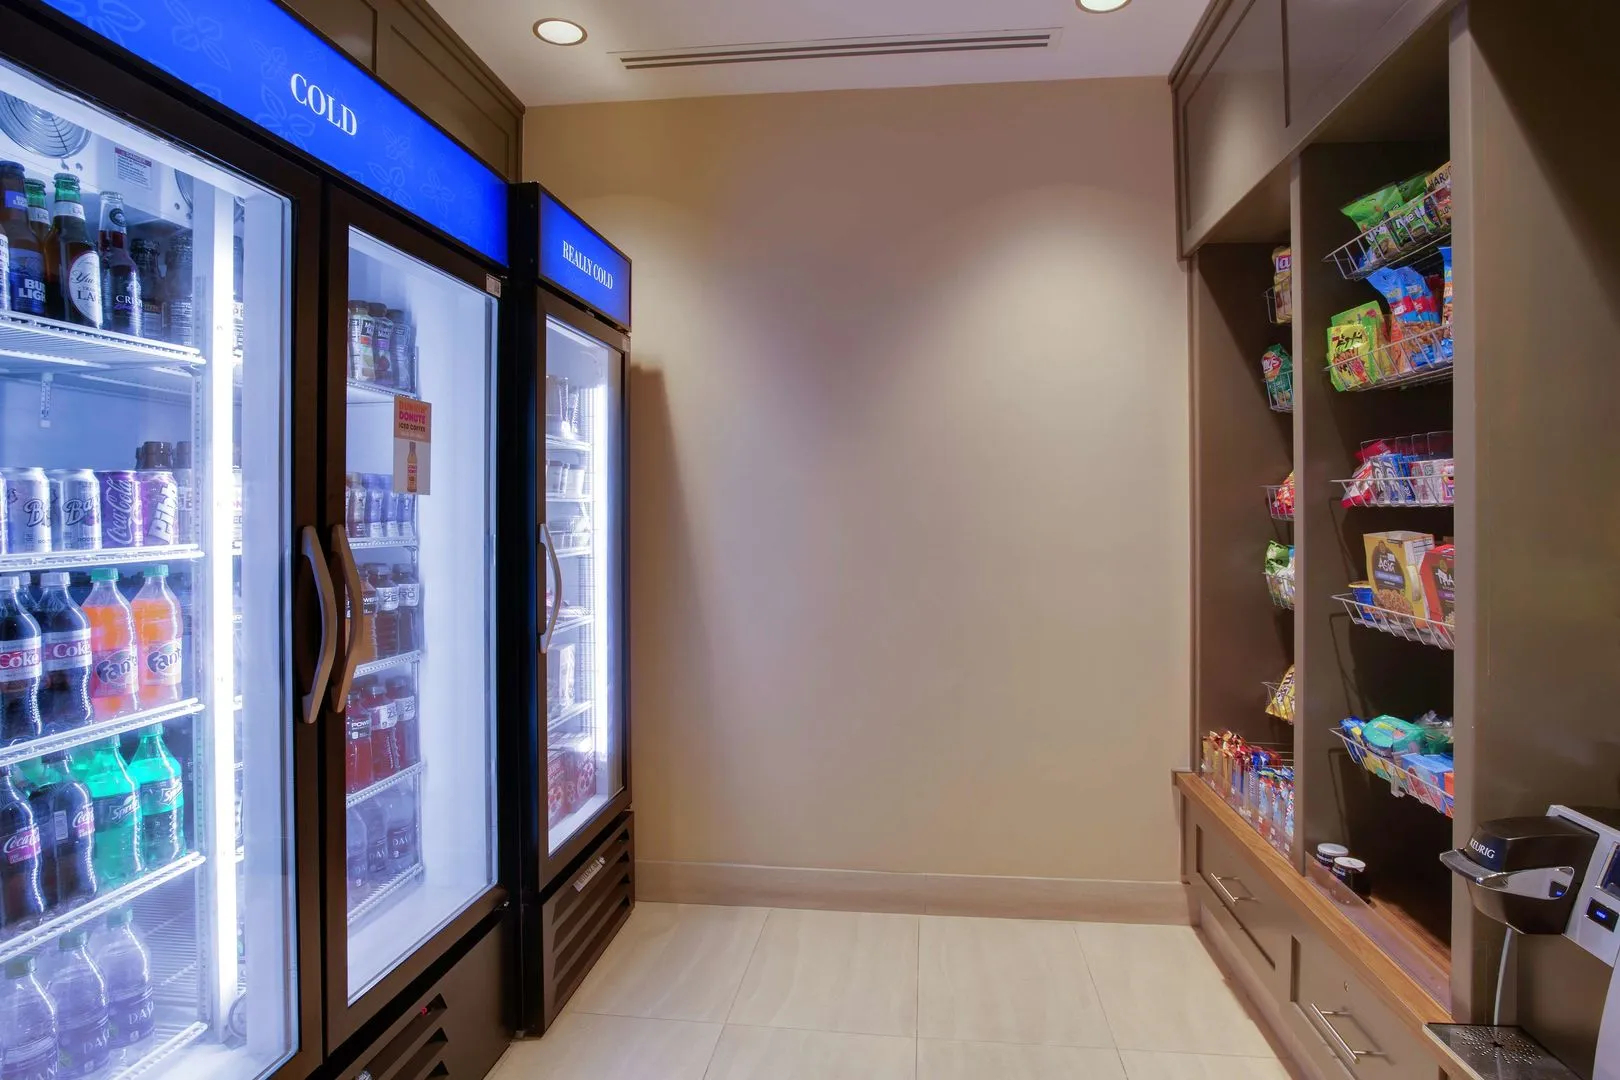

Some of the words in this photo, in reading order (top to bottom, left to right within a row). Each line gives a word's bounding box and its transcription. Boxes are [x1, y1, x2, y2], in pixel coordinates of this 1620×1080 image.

[290, 73, 358, 136] COLD
[562, 240, 593, 277] REALLY
[593, 264, 613, 290] COLD
[398, 411, 426, 424] DONUTS
[410, 424, 426, 432] COFFEE
[1469, 838, 1496, 860] KEURIG
